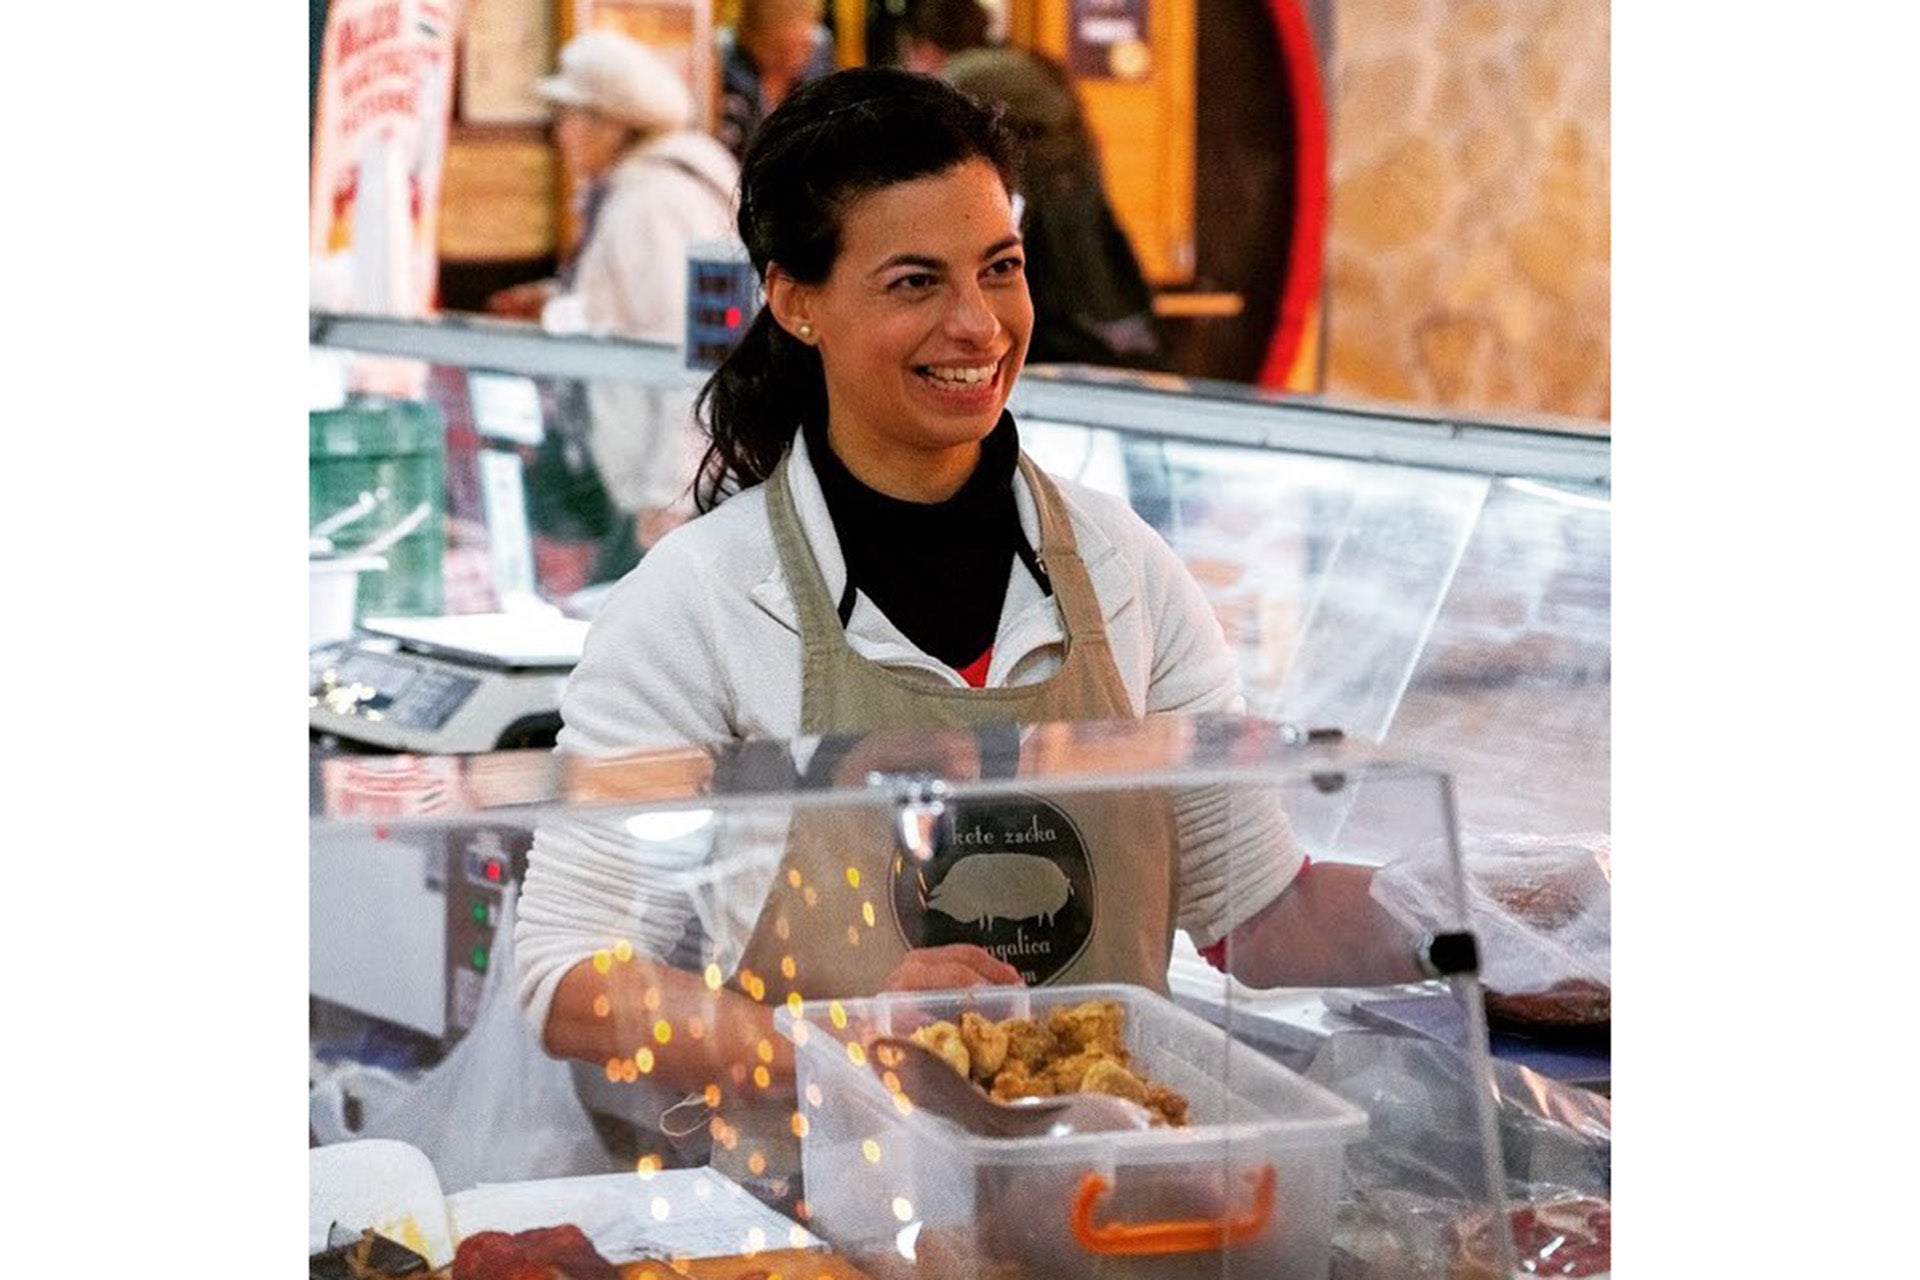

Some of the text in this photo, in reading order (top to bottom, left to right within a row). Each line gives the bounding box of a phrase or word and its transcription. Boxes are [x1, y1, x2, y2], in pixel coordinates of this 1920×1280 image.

[952, 814, 1056, 845] kete zsóka
[983, 927, 1050, 963] ngalica
